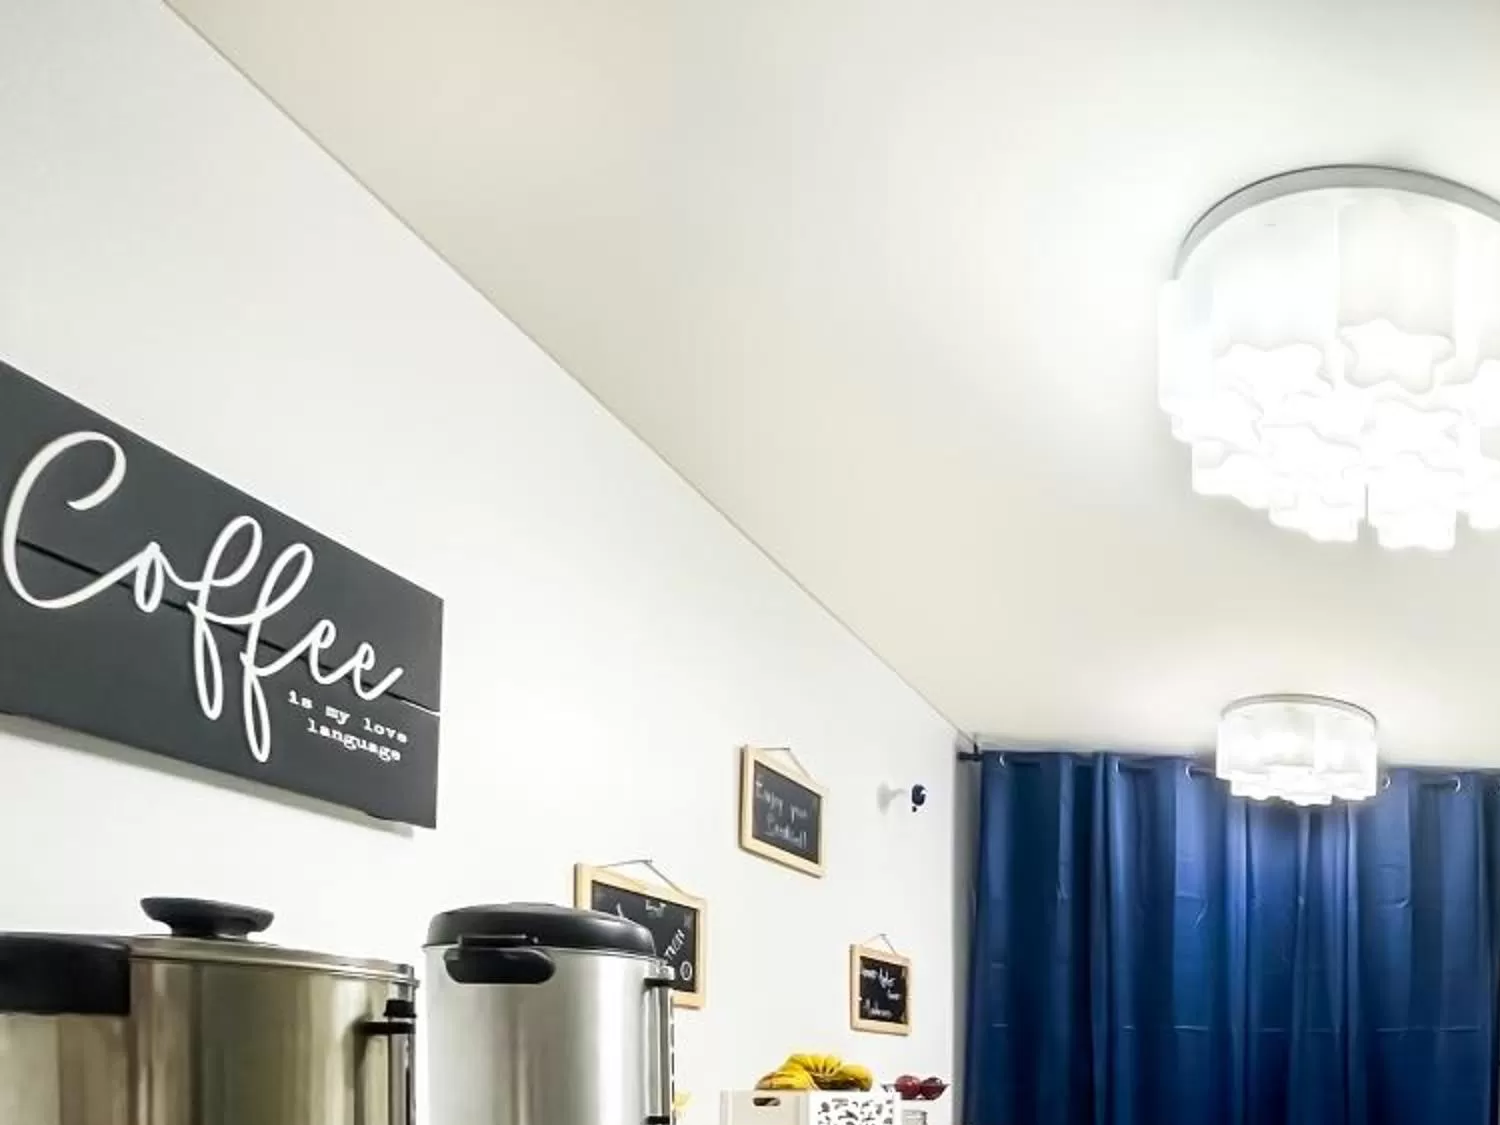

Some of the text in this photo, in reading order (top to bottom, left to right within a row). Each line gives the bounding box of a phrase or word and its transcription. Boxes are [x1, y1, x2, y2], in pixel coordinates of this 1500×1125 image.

[3, 430, 404, 763] Coffee
[288, 689, 408, 743] is my love
[307, 717, 401, 762] language
